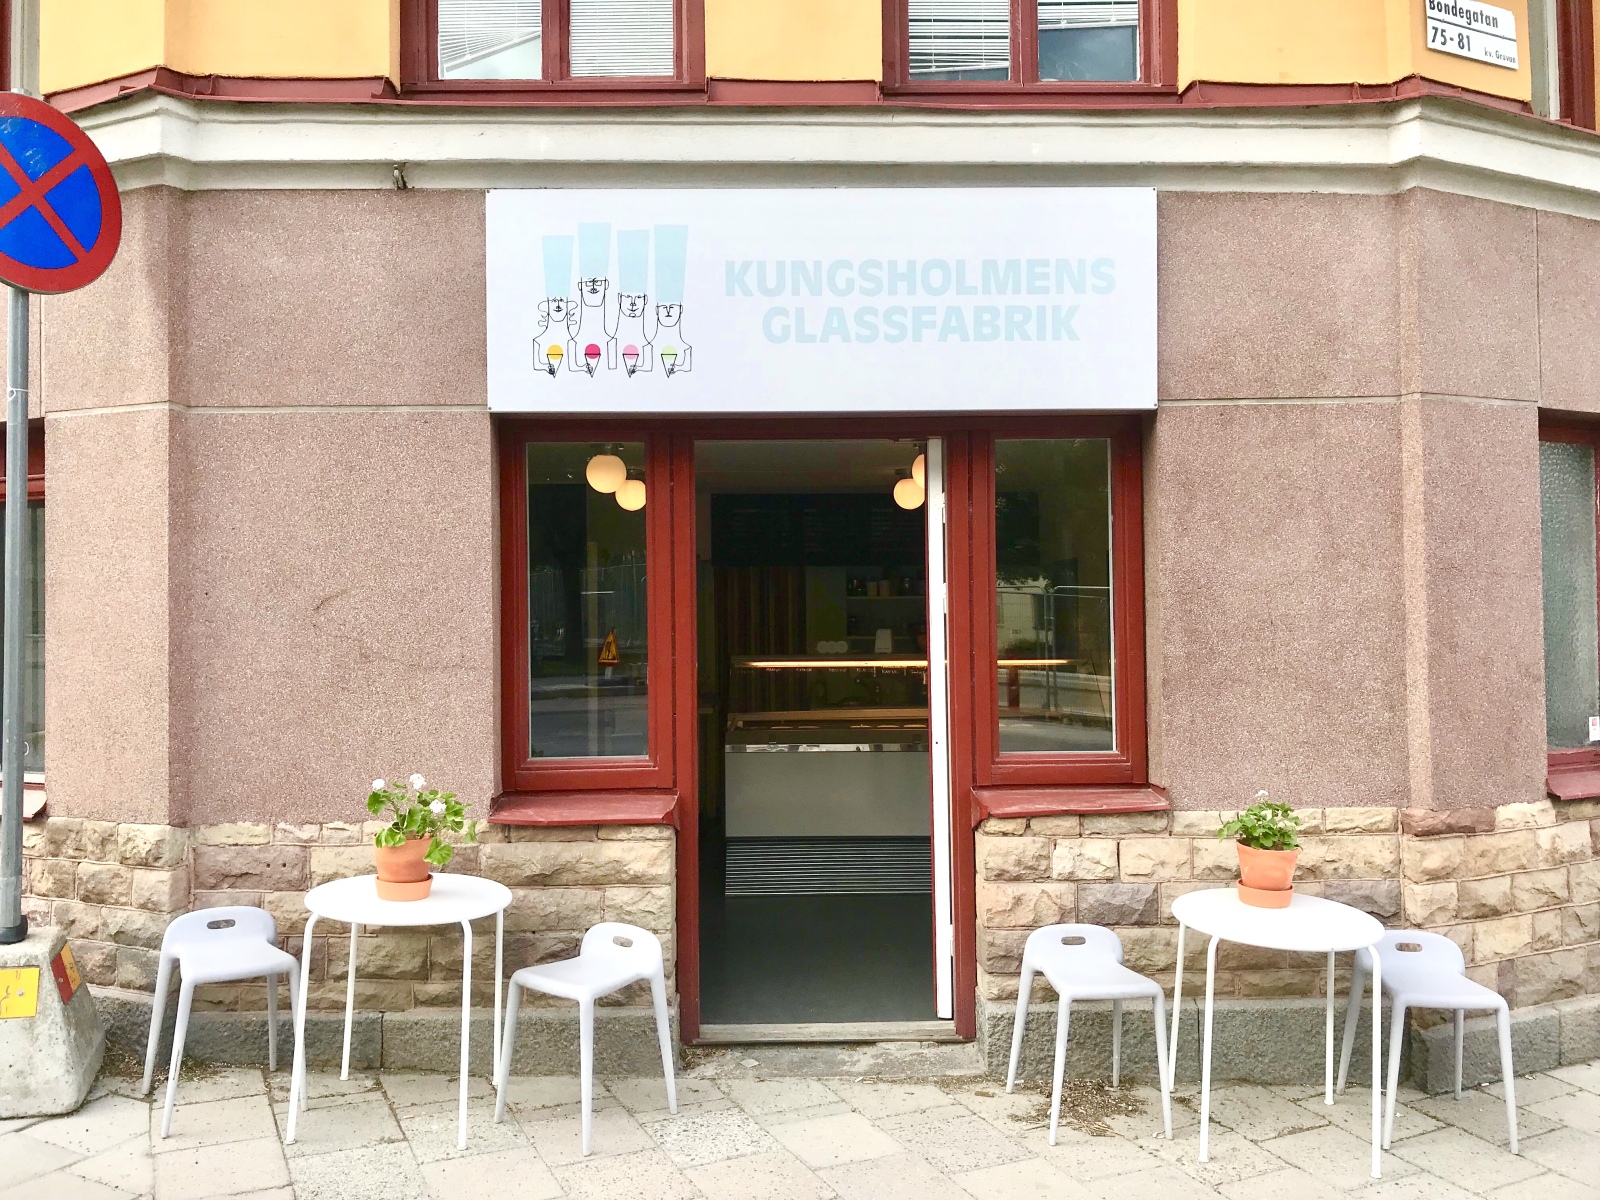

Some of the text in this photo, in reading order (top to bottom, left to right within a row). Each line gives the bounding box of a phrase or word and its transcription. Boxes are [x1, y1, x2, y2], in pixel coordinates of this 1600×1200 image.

[1429, 0, 1498, 28] Bondegatan
[1484, 47, 1494, 58] kv.
[725, 258, 1116, 297] KUNGSHOLMENS
[762, 305, 1080, 343] GLASSFABRIK
